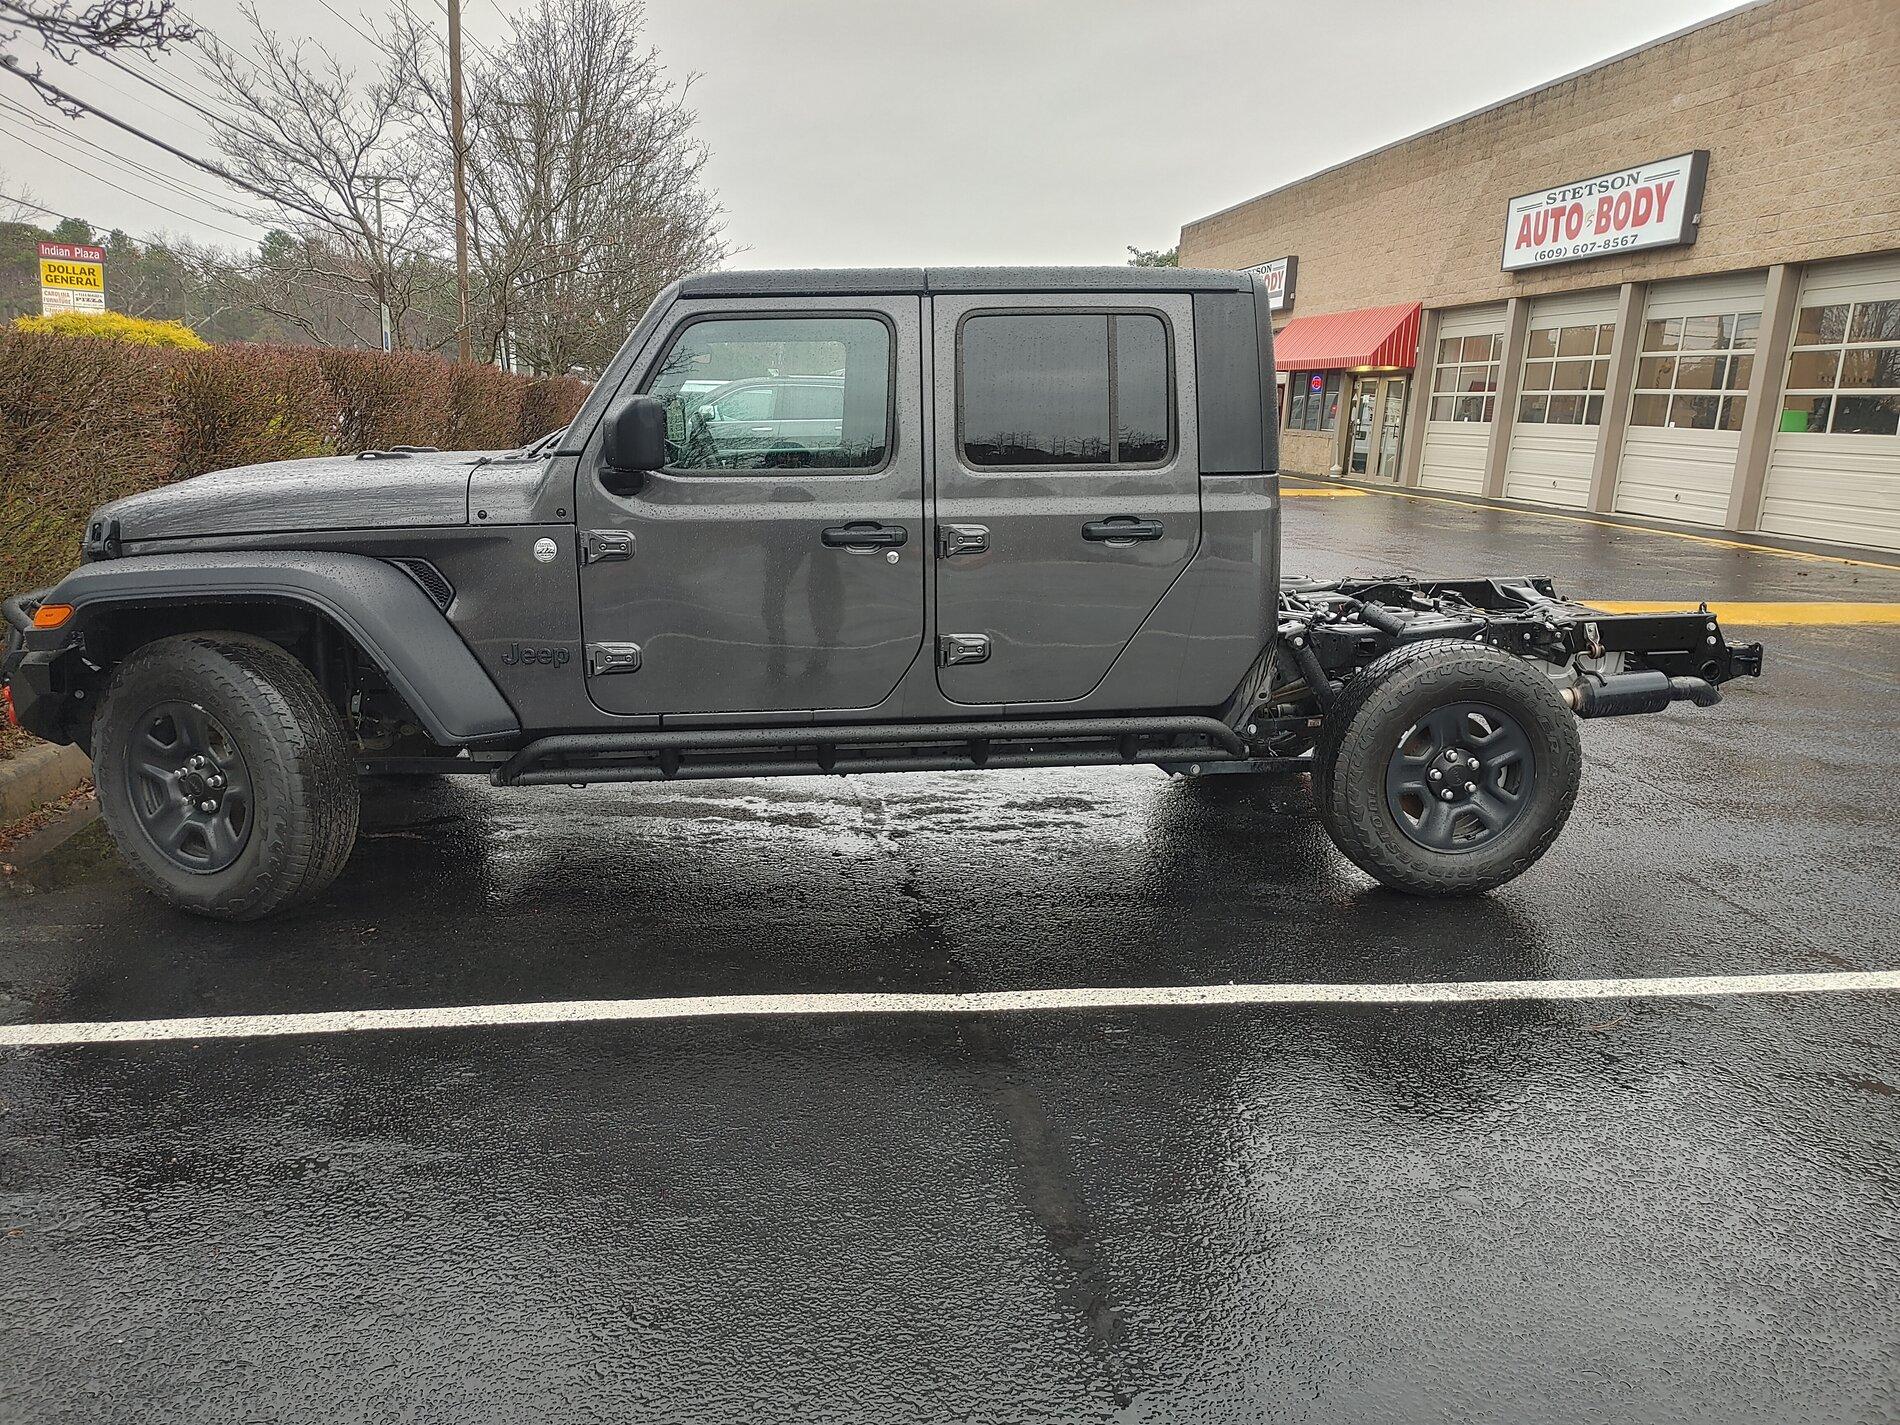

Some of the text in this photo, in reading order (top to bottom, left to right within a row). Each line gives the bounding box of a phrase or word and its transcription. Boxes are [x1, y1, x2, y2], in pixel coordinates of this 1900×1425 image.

[1546, 171, 1641, 205] STETSON
[1515, 202, 1583, 250] AUTO
[1594, 180, 1675, 235] BODY
[41, 244, 100, 259] Indian Plaza
[1534, 234, 1638, 262] (609) 607-8567
[45, 274, 99, 287] GENERAL
[48, 264, 96, 276] DOLLAR
[1264, 270, 1285, 291] ODY
[501, 641, 570, 668] Jeep
